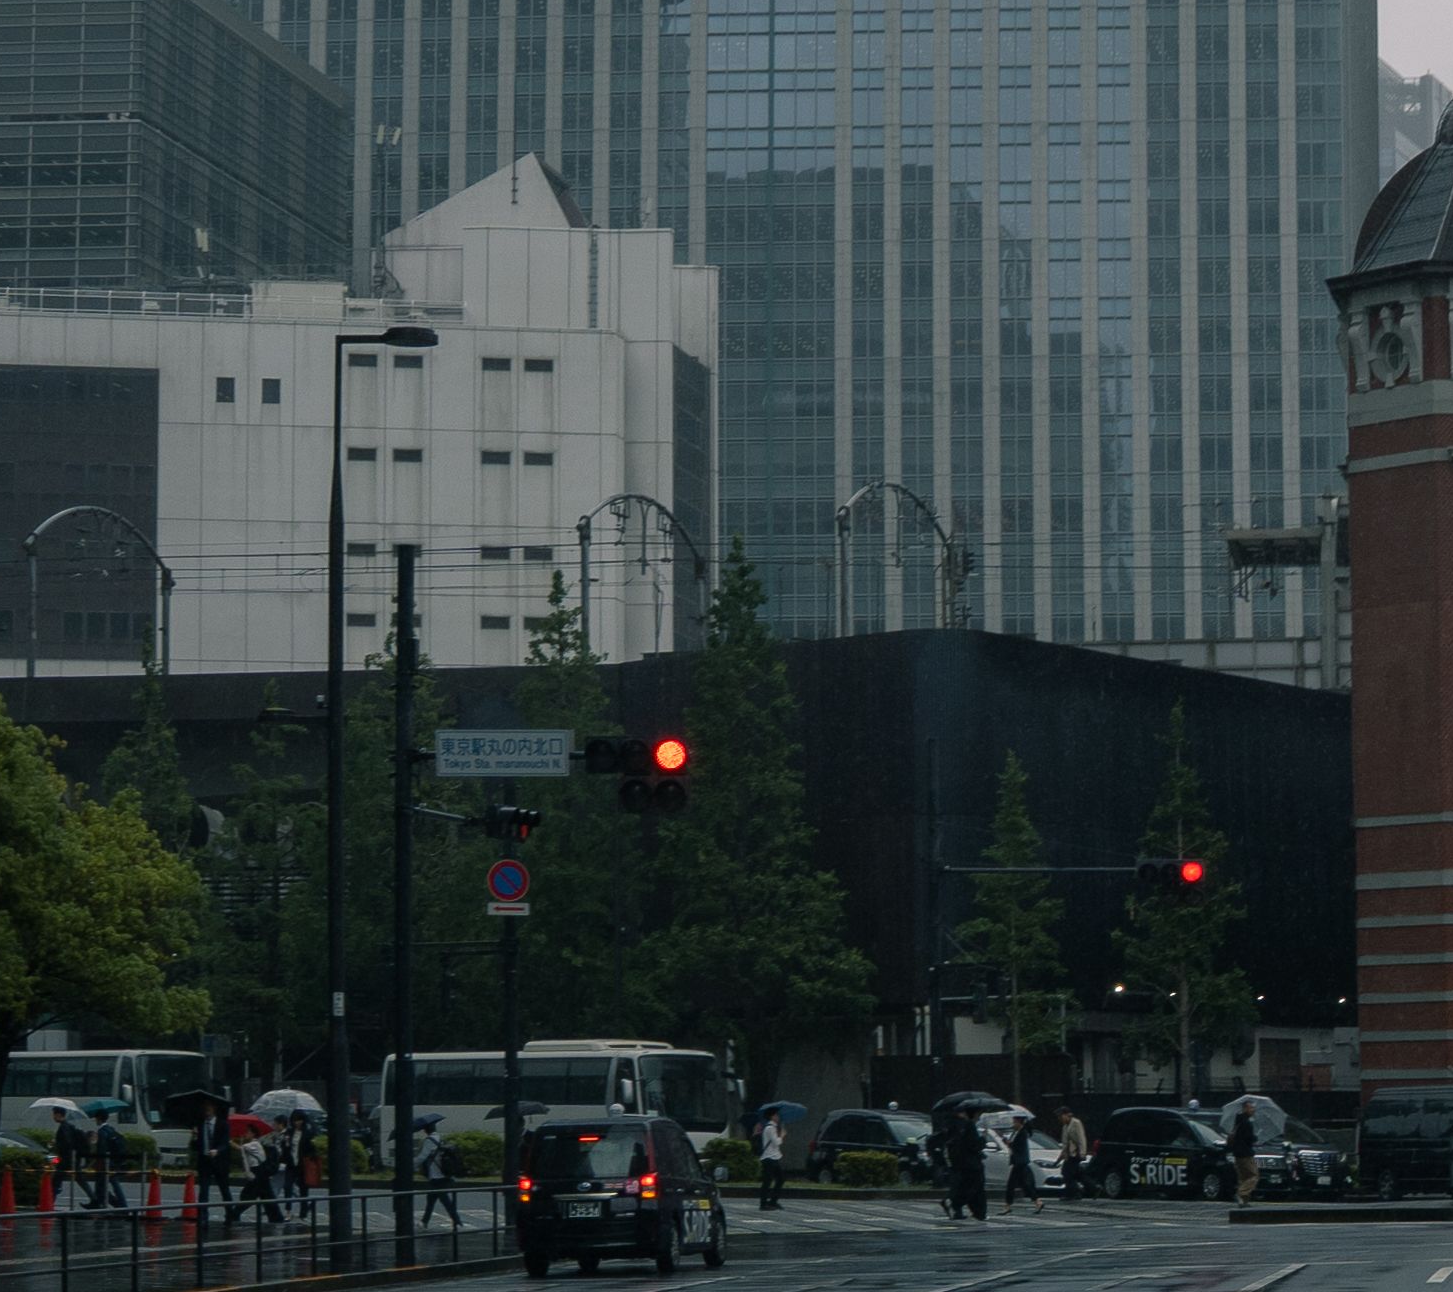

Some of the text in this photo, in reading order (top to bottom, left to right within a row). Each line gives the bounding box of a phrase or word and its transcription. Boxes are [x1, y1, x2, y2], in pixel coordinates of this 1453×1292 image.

[440, 737, 563, 756] 東京駅丸の内北口
[444, 758, 471, 770] Tokyo
[1130, 1163, 1188, 1186] S.RIDE
